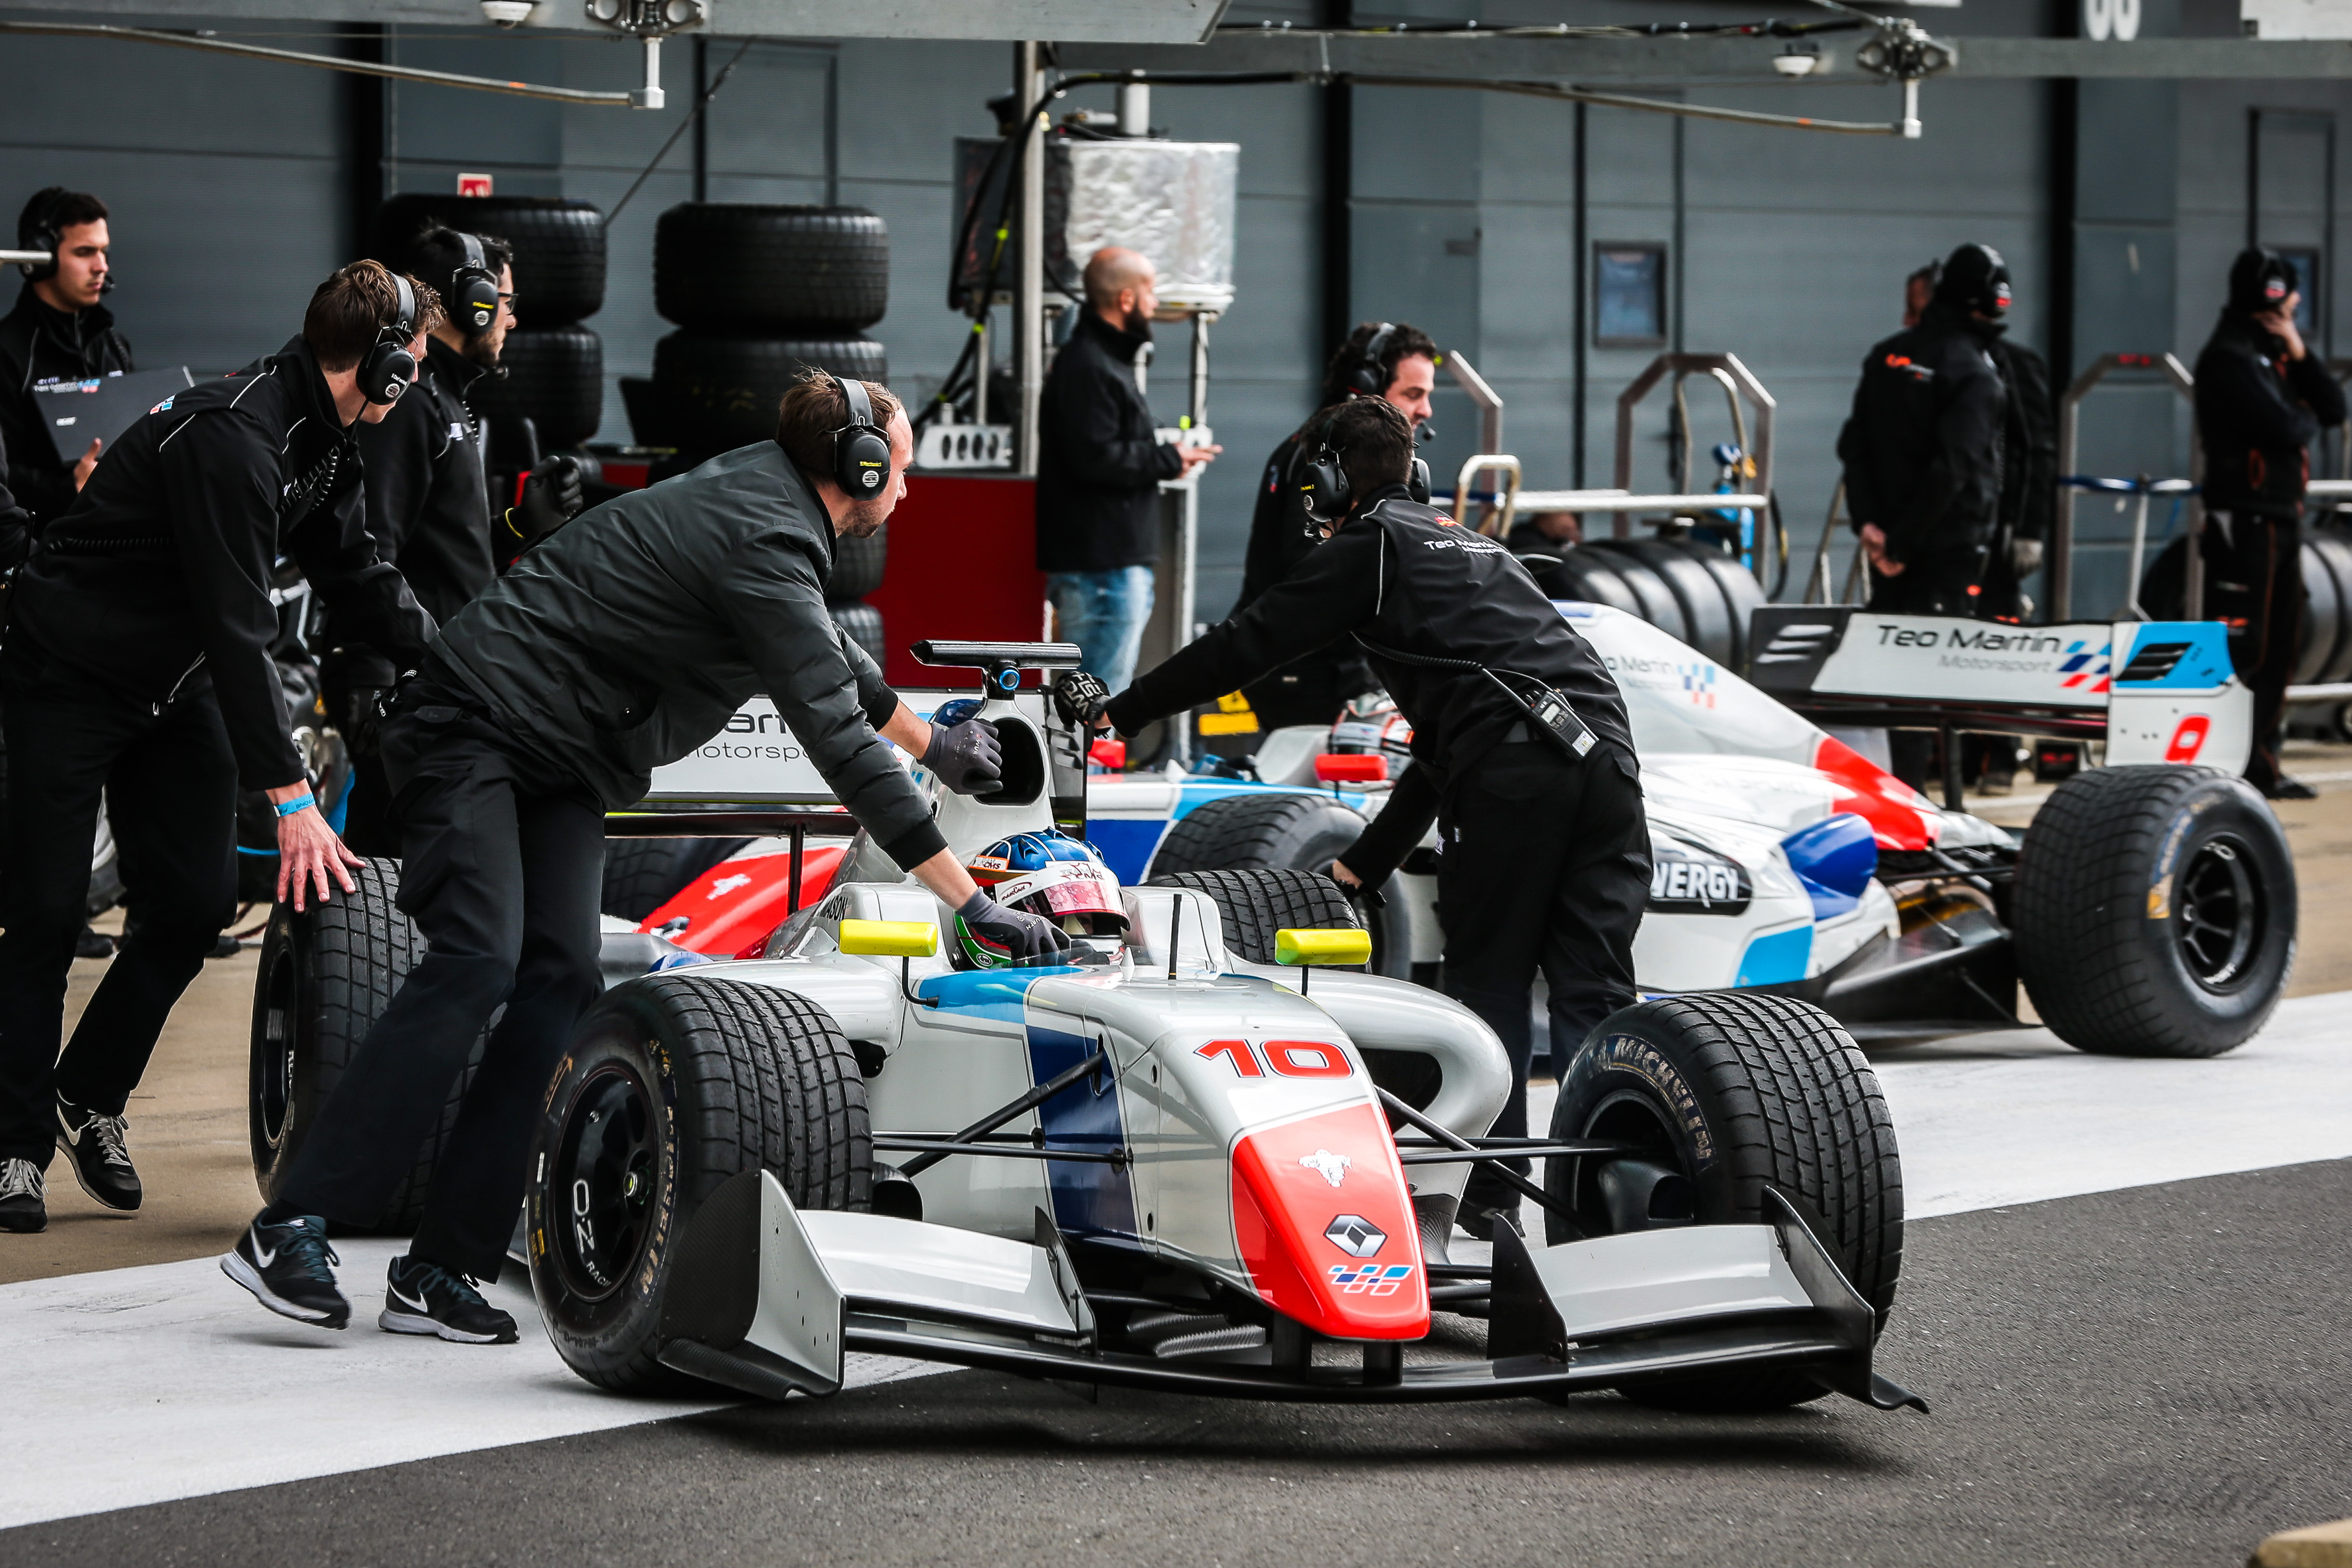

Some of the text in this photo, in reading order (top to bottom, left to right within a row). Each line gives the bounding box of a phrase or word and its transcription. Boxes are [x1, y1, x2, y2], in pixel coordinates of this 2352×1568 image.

[1424, 540, 1455, 550] Teo
[1877, 624, 1939, 648] Teo
[1938, 653, 2052, 672] Motorsport
[1650, 862, 1739, 909] NERGY
[1194, 1038, 1354, 1080] 10
[1612, 1037, 1712, 1160] MICHELIN
